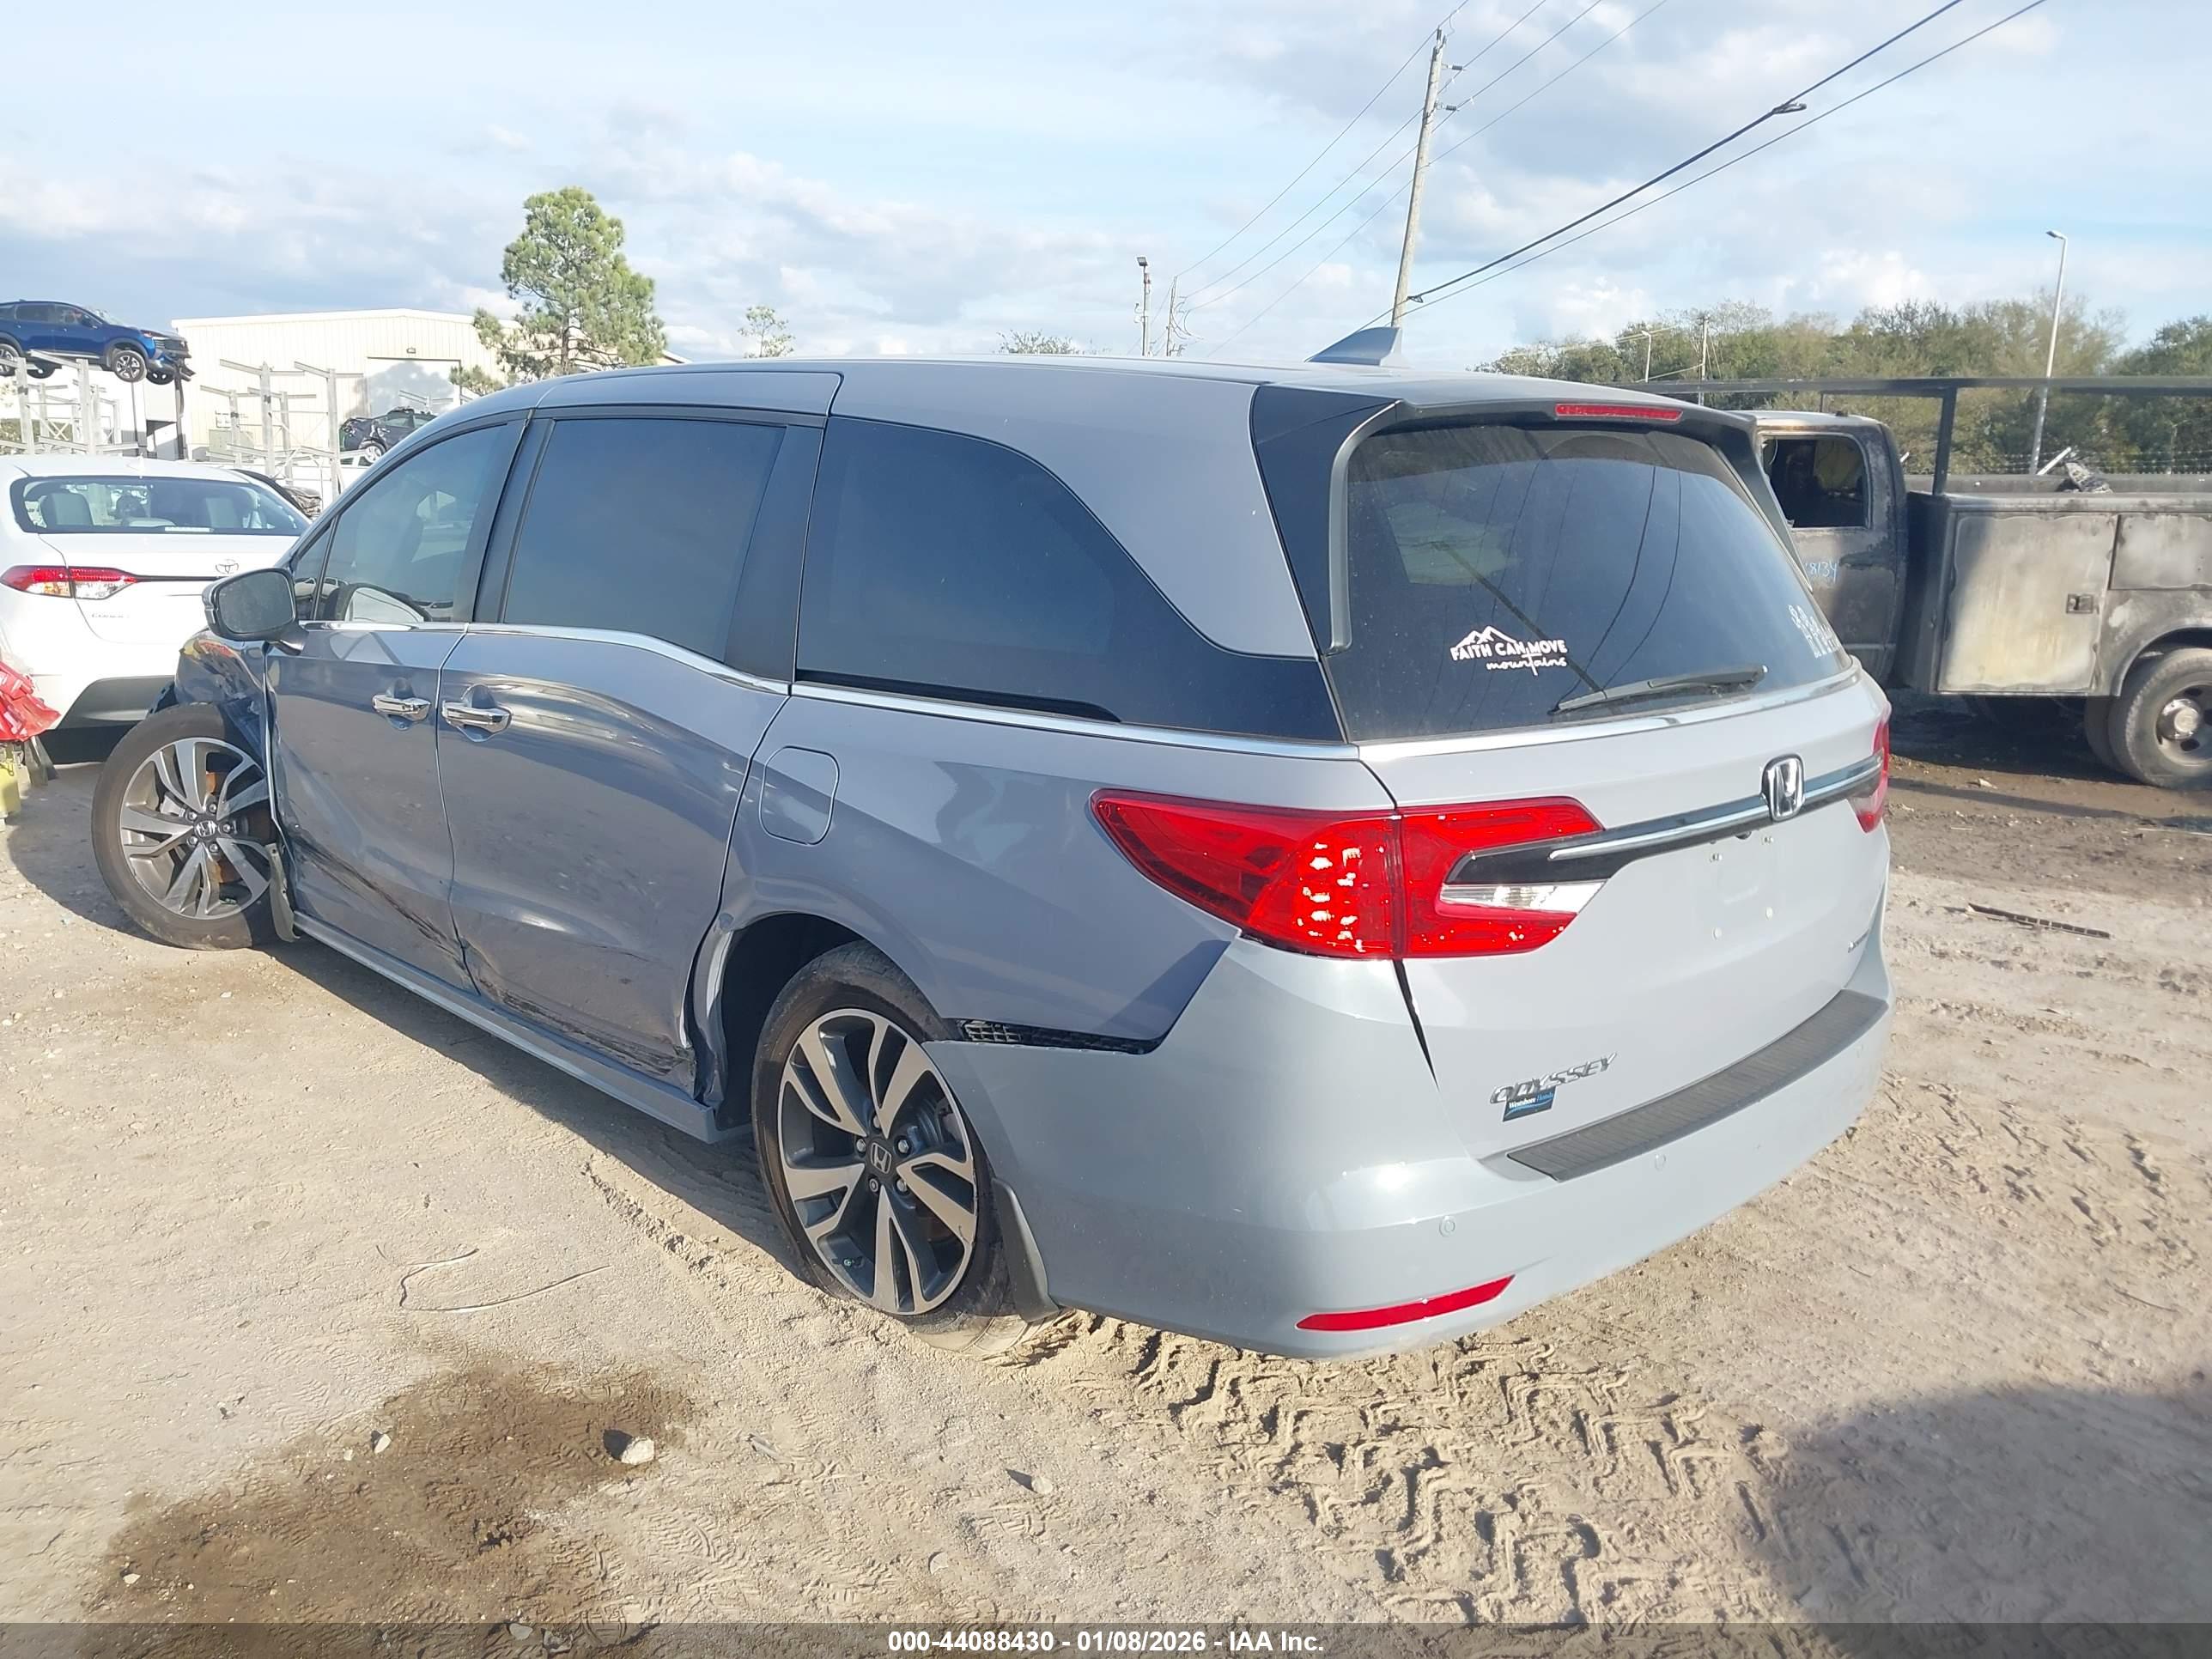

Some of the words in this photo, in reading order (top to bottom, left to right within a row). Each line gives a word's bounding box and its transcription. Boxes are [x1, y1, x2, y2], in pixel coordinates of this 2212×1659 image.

[1450, 643, 1493, 661] FAITH
[1494, 642, 1526, 656] CAN
[1527, 640, 1568, 654] MOVE
[1486, 655, 1567, 677] mountains
[1490, 1052, 1617, 1103] ODYSSEY
